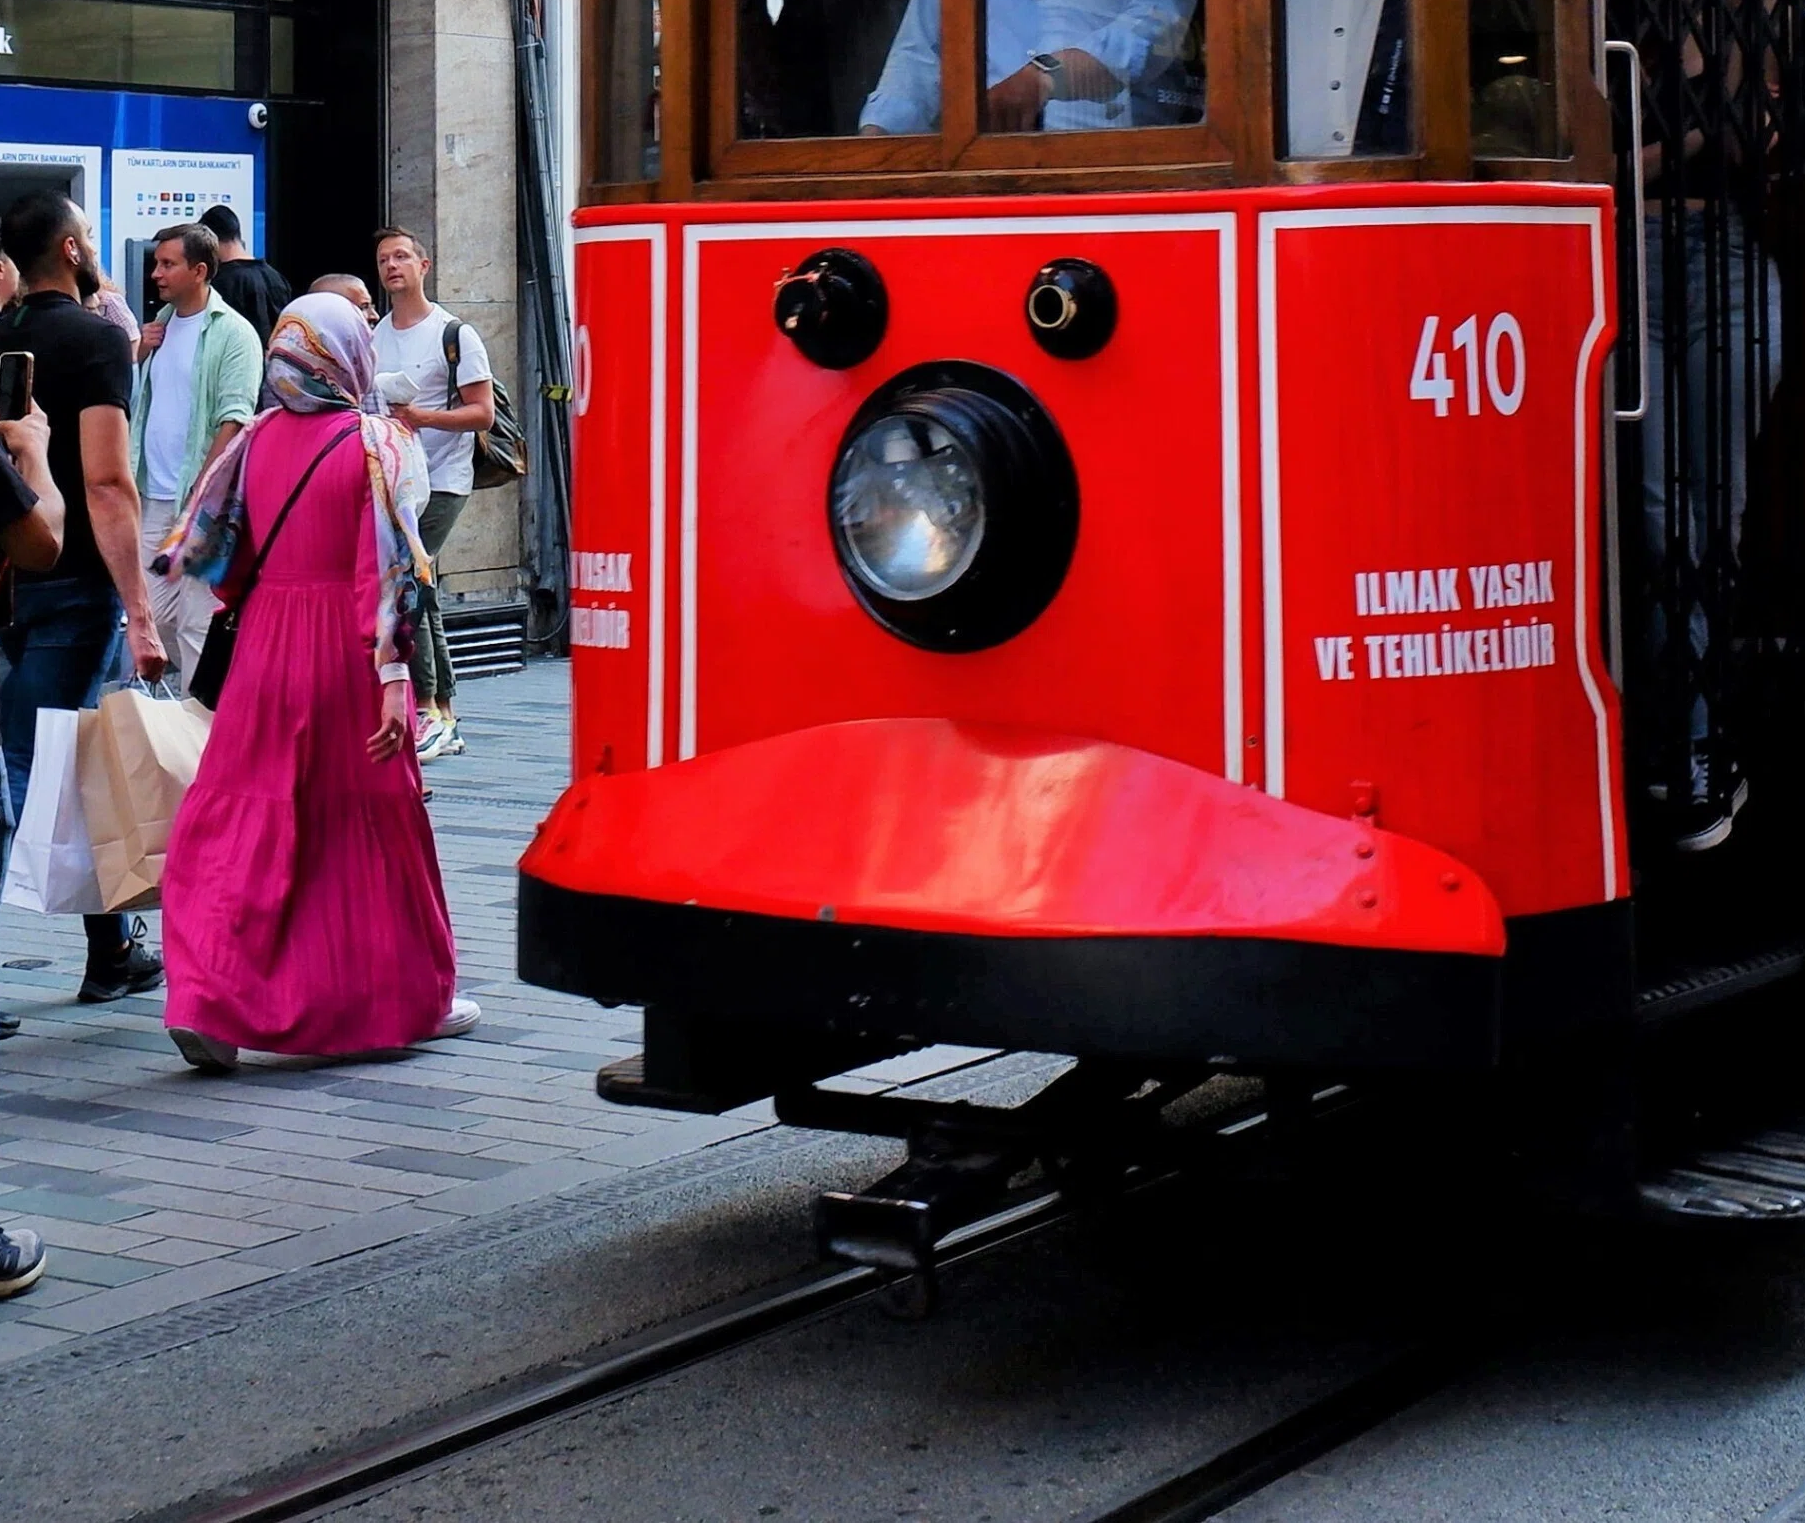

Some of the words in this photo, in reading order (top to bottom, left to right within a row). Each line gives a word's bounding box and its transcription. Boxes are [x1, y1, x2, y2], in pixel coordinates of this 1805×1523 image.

[127, 156, 141, 167] TÜM
[1409, 312, 1526, 418] 410
[1355, 567, 1461, 616] ILMAK
[1468, 560, 1555, 610] YASAK
[1314, 636, 1355, 681] VE
[1364, 616, 1555, 680] TEHLİKELİDİR
